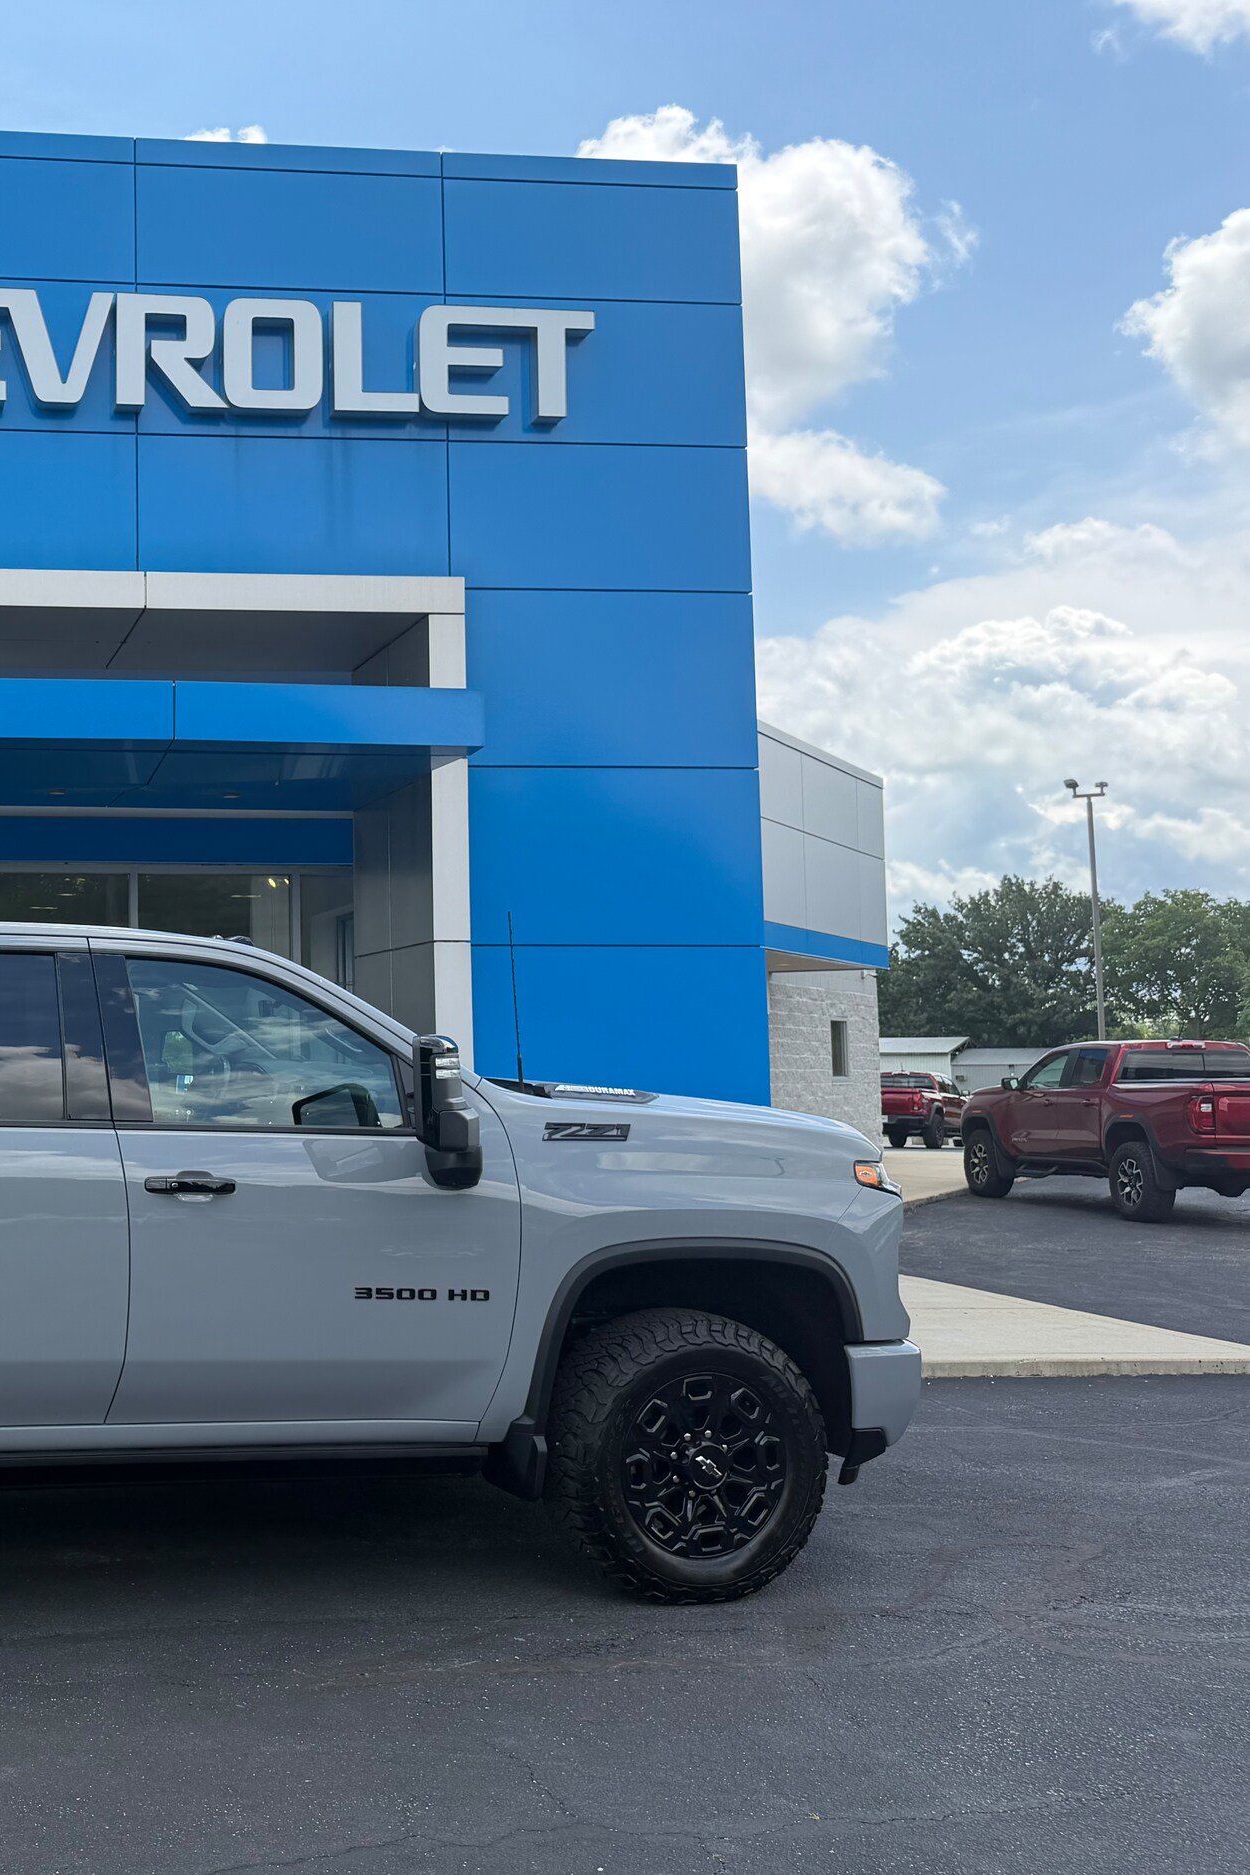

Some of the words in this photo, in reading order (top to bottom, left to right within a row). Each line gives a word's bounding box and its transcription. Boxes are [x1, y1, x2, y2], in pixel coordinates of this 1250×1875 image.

[588, 1086, 636, 1096] DURAMAX
[355, 1287, 437, 1300] 3500
[448, 1289, 490, 1301] HD
